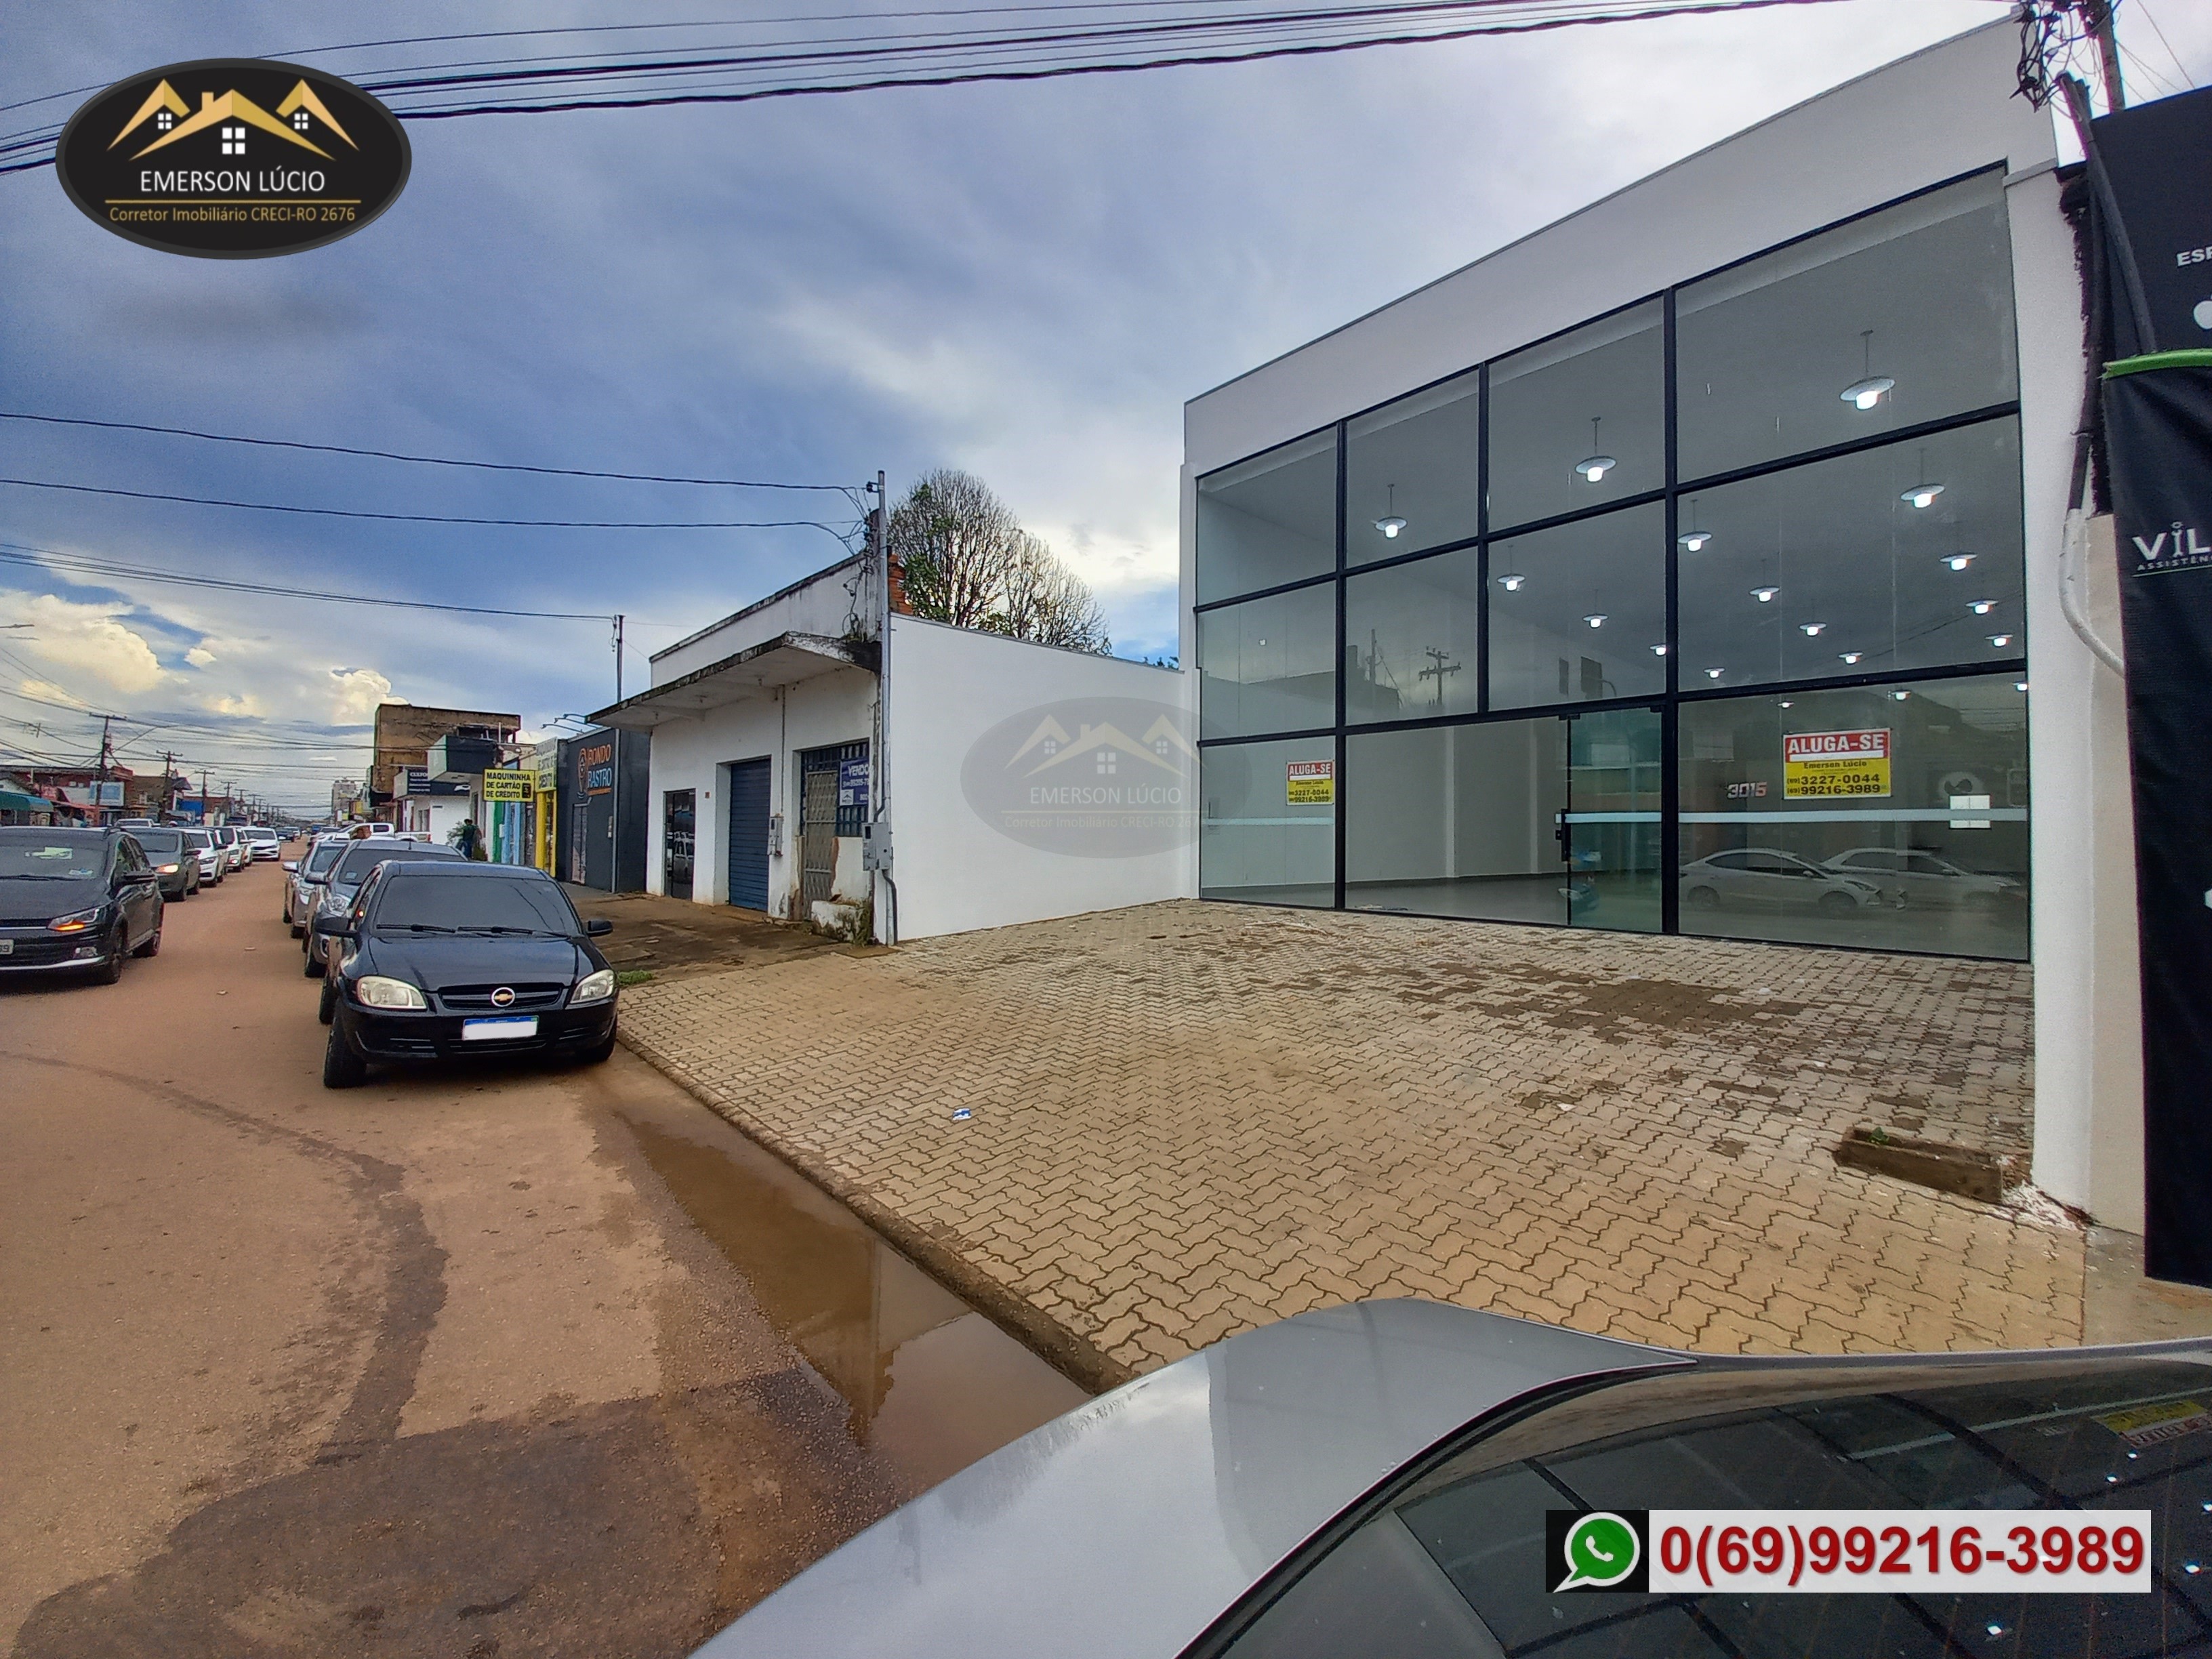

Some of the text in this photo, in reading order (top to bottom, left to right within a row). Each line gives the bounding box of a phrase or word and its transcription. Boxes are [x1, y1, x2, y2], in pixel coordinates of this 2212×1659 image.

[2137, 556, 2212, 571] ASSISTÊN
[1787, 733, 1884, 754] ALUGA-SE
[587, 743, 611, 766] RONDO
[487, 772, 531, 781] MAQUININHA
[1289, 763, 1331, 775] ALUGA-SE
[496, 781, 520, 790] CARTÃO
[588, 768, 612, 787] RASTRO
[1727, 781, 1767, 798] 3015
